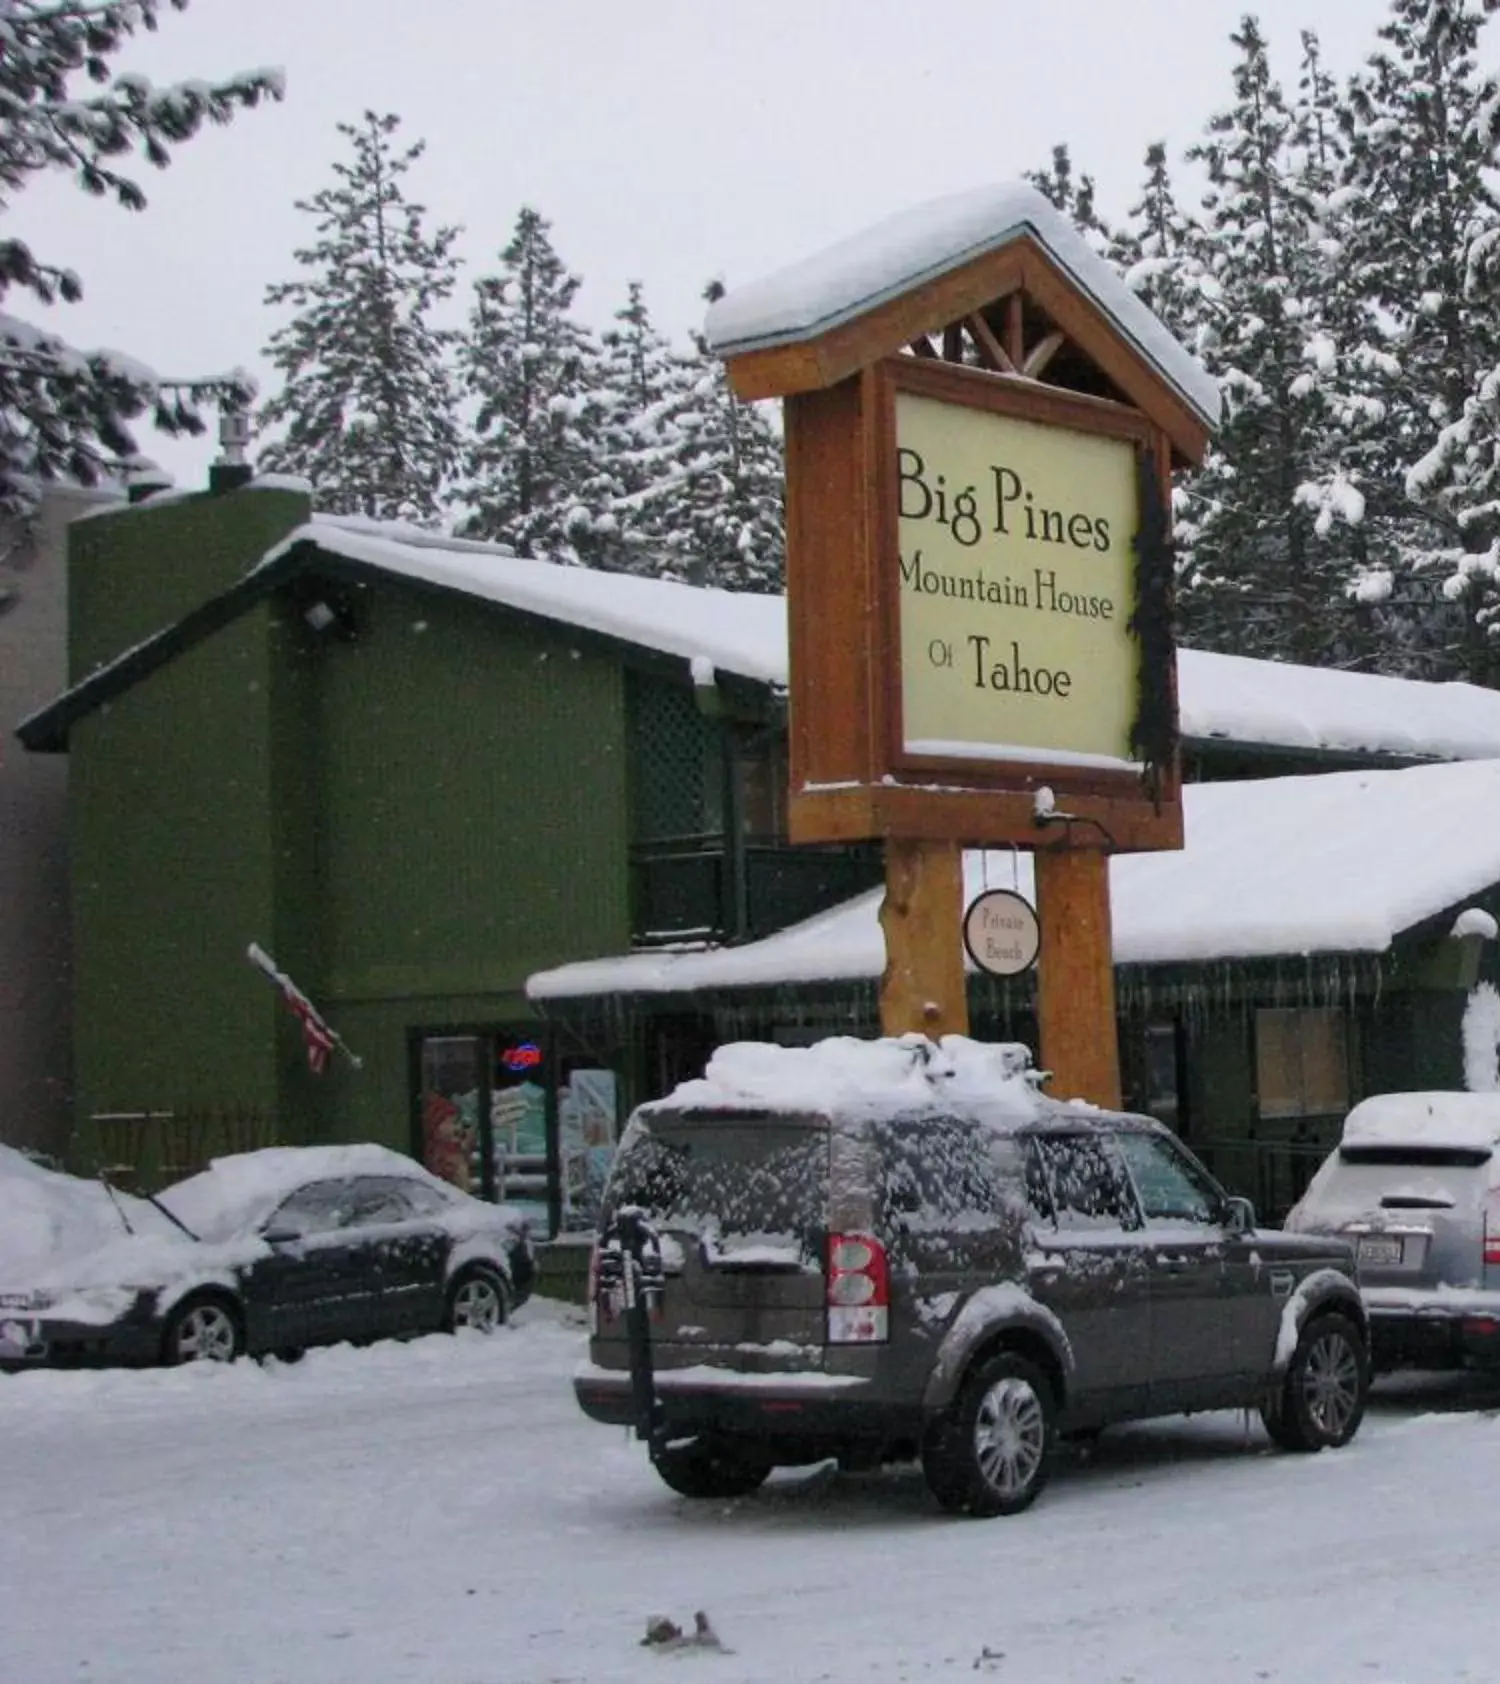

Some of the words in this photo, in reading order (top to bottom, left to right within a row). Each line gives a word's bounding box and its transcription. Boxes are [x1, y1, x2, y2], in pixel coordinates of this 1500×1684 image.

[897, 447, 982, 547] Big
[990, 464, 1111, 553] Pines
[898, 549, 1029, 608] Mountain
[1033, 568, 1115, 620] House
[967, 634, 1072, 698] Tahoe
